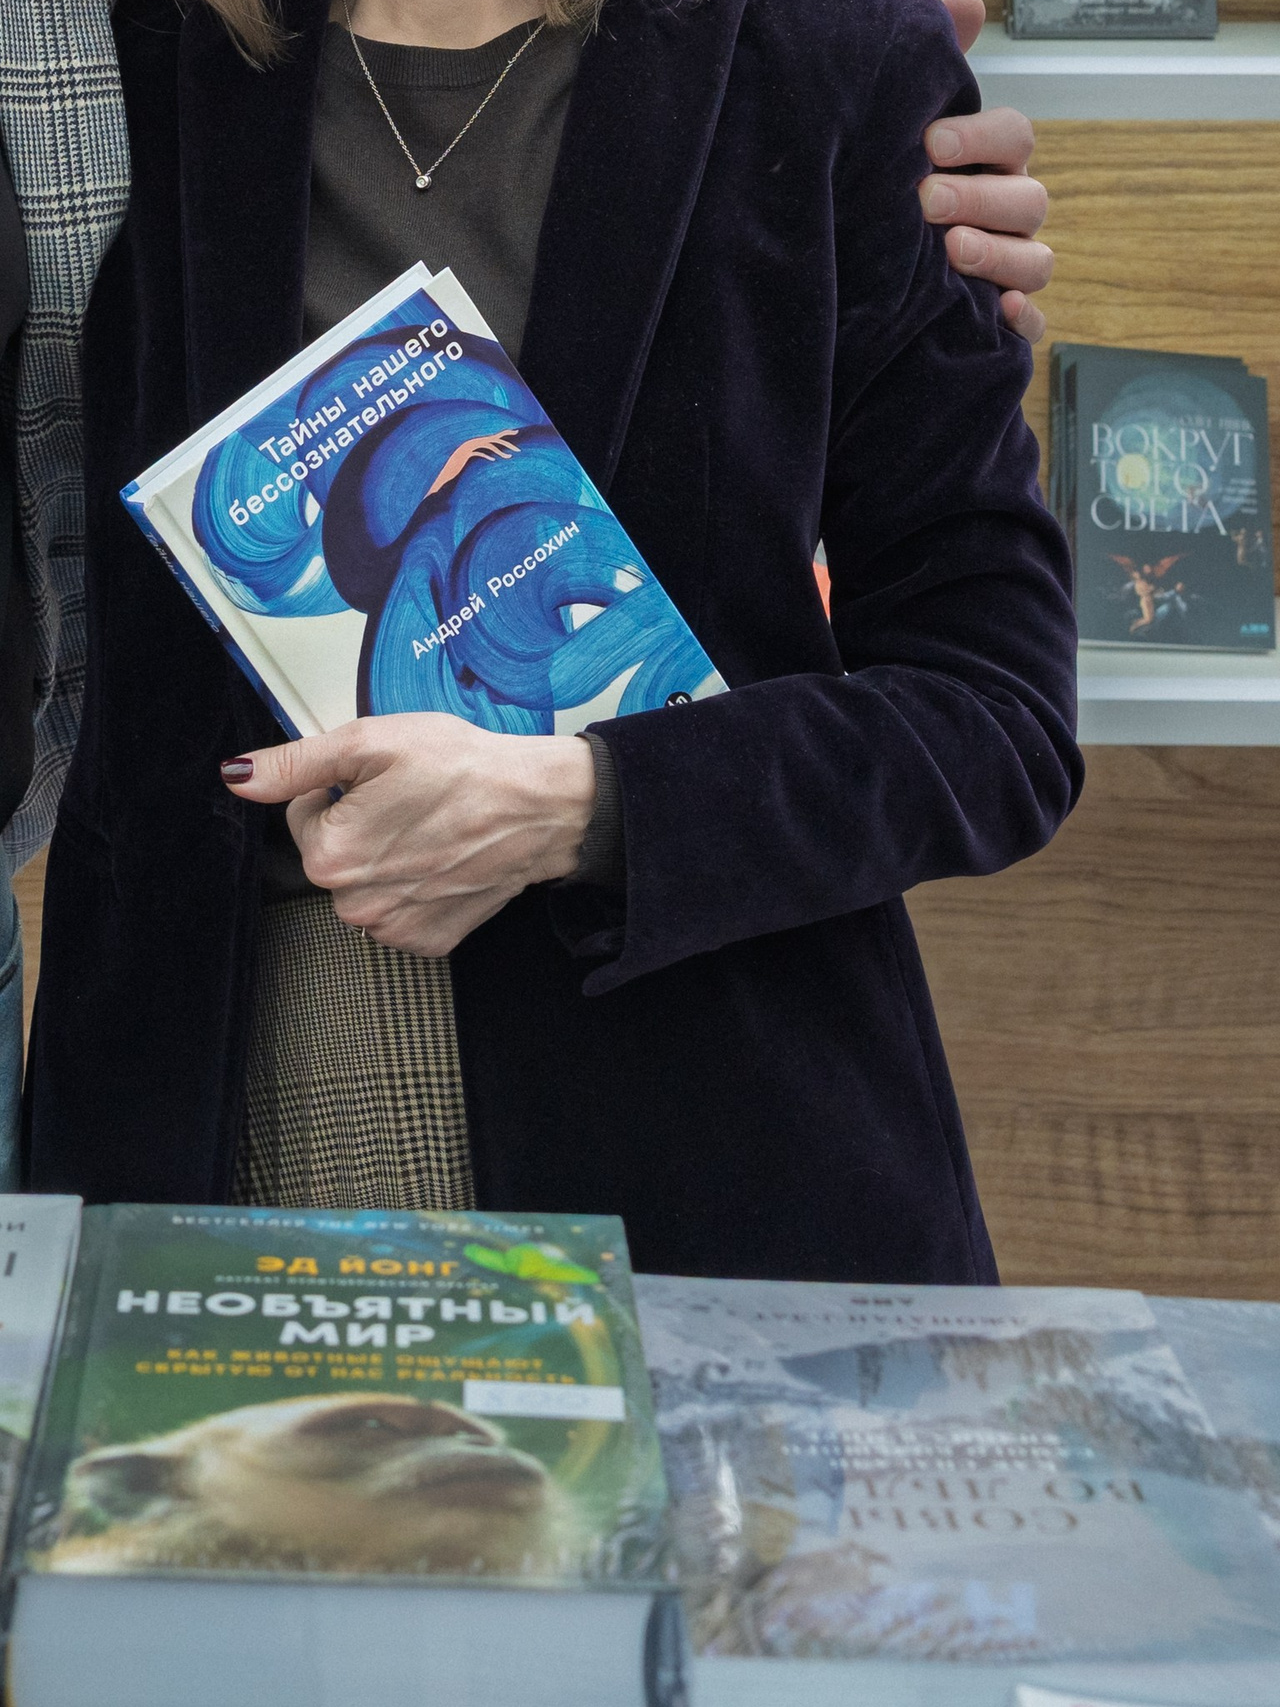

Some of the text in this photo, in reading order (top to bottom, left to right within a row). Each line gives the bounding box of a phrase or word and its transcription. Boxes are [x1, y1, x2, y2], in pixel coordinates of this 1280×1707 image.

[259, 318, 450, 465] Тайны нашего
[227, 339, 465, 527] бессознательного
[1091, 422, 1255, 472] ВОКРУГ
[1090, 458, 1210, 494] ТОГО
[1091, 494, 1227, 536] СВЕТА
[410, 519, 581, 660] Андрей Россохин
[171, 1215, 545, 1234] БЕСТСЕЛЛЕР THE NEW YORK TIMES
[255, 1255, 460, 1278] ЭД ЙОНГ
[117, 1288, 598, 1328] НЕОБЪЯТНЫЙ
[279, 1322, 437, 1350] МИР
[135, 1360, 576, 1385] СКРЫТУЮ ОТ НАС РЕАЛЬНОСТЬ
[166, 1348, 544, 1371] КАК ЖИВОТНЫЕ ОЩУЩАЮТ
[1044, 1479, 1146, 1504] ВО
[847, 1505, 1082, 1534] СОВЫ
